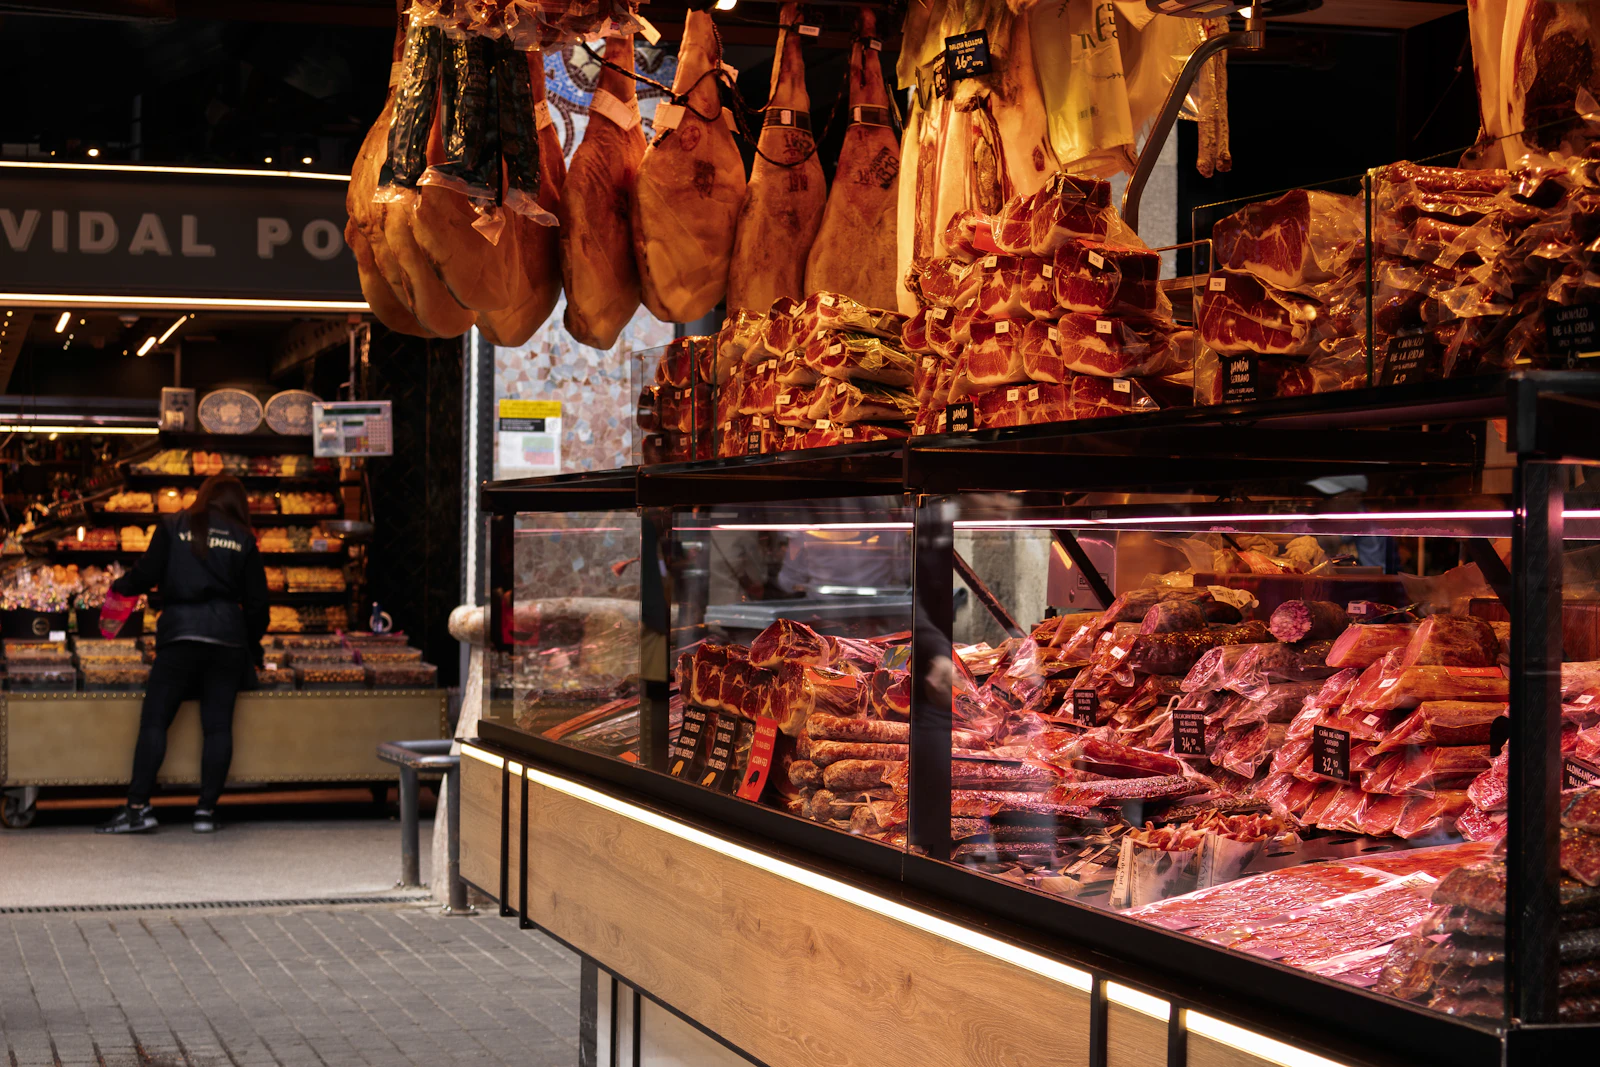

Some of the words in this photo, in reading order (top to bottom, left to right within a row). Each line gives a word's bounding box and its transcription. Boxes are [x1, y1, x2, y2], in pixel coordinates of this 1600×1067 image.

[0, 208, 217, 257] VIDAL
[257, 216, 345, 261] PO
[1556, 307, 1589, 321] CHORIZO
[1552, 325, 1563, 337] DE
[1563, 323, 1573, 335] LA
[1574, 321, 1596, 334] RIOJA
[1230, 356, 1249, 375] JAMÓN
[1230, 373, 1250, 384] SERRANO
[952, 405, 968, 421] JAMÓN
[1318, 729, 1328, 738] CAÑA
[1328, 731, 1334, 739] DE
